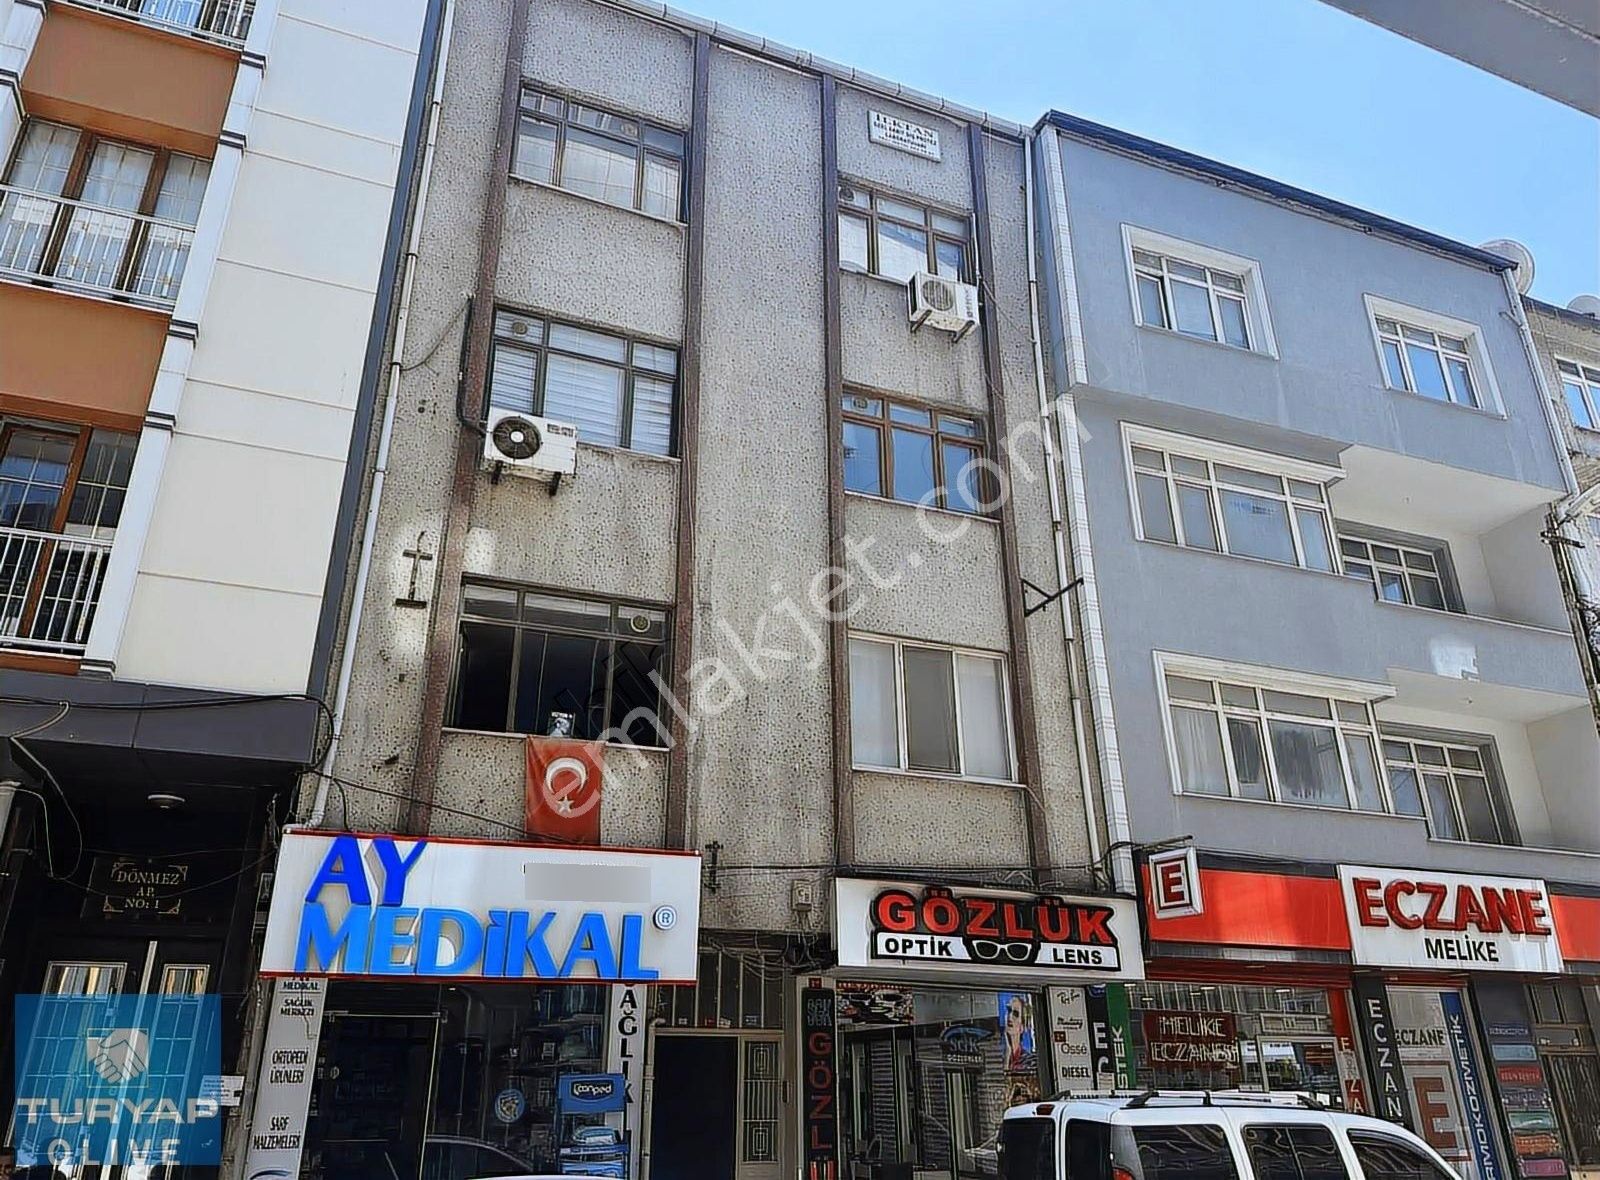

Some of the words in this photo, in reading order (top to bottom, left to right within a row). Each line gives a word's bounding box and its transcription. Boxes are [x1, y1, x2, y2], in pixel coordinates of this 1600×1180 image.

[116, 868, 181, 885] DÖNMEZ
[304, 834, 428, 907] AY
[1160, 864, 1185, 902] E
[876, 889, 1113, 944] GÖZLÜK
[1352, 876, 1551, 935] ECZANE
[294, 902, 660, 978] MEDİKAL
[884, 934, 953, 957] OPTİK
[1052, 947, 1103, 965] LENS
[1424, 933, 1499, 962] MELİKE
[272, 1047, 309, 1065] ORTOPEDİ
[1061, 1066, 1091, 1078] DIESEL
[1368, 999, 1405, 1126] ECZAN
[270, 1116, 290, 1132] SARF
